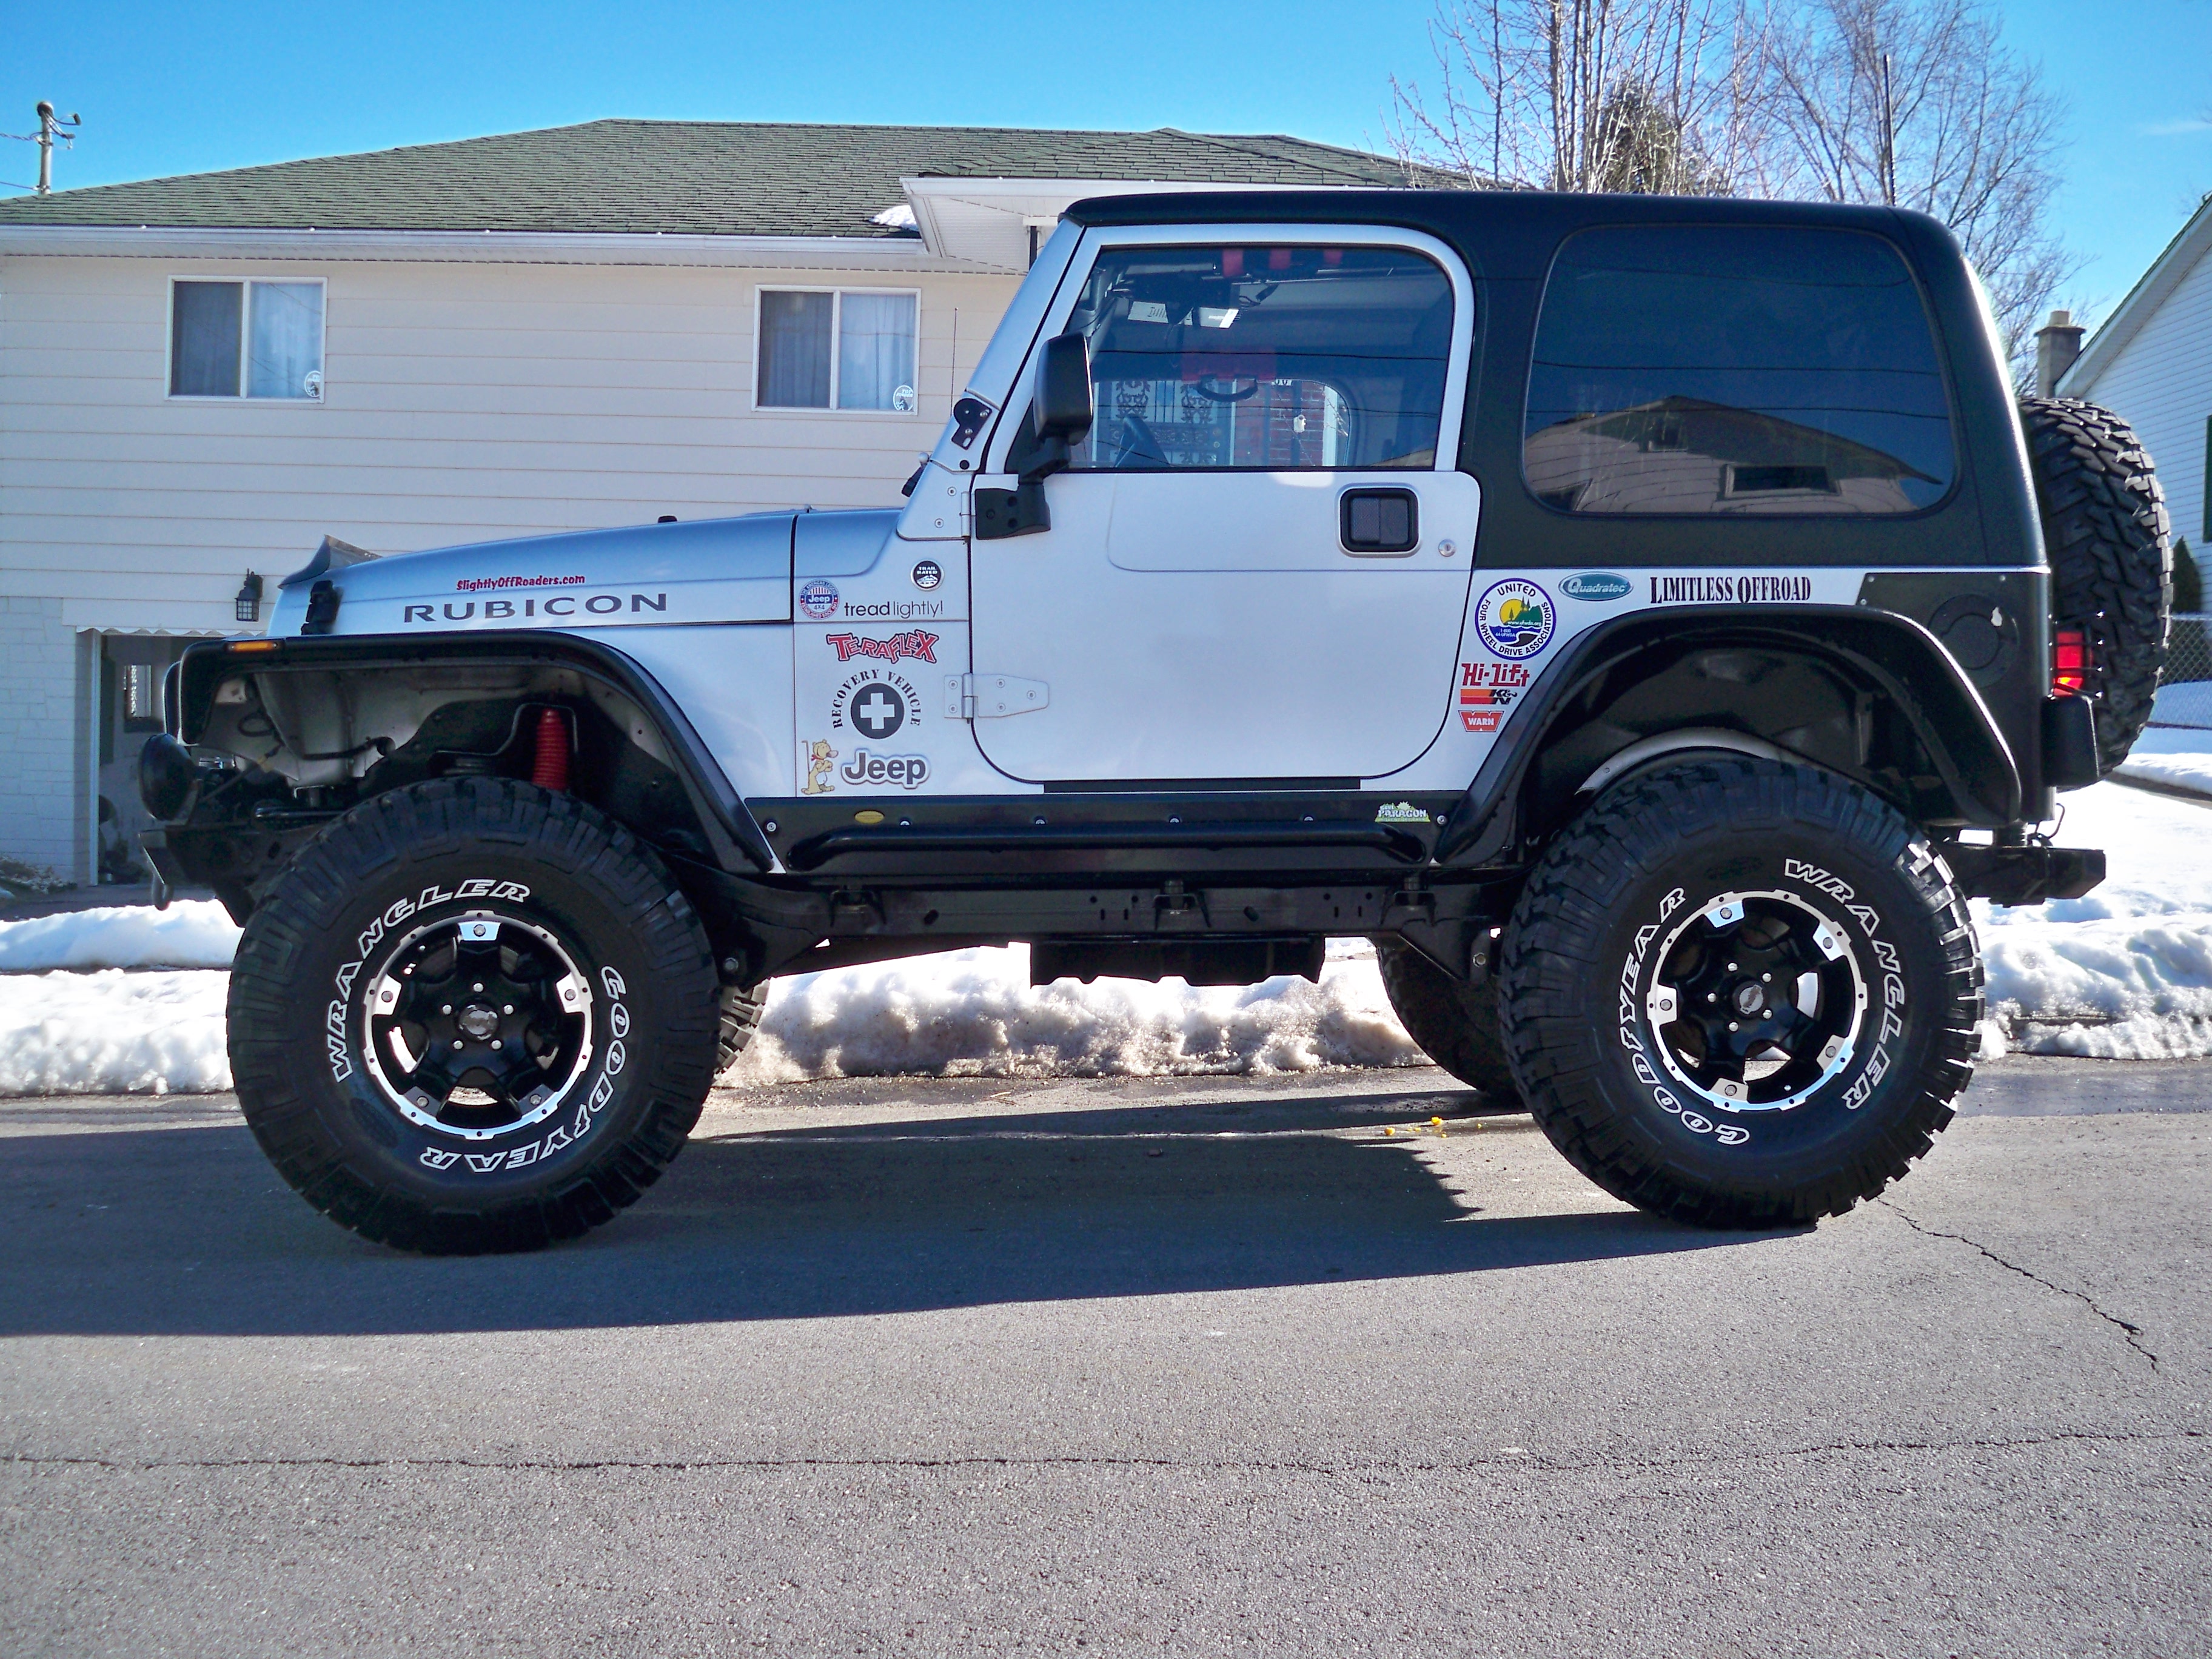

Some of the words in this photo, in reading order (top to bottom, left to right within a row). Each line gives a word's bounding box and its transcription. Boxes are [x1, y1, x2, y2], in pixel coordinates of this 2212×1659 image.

[456, 575, 585, 592] SlightlyOffRoaders.com
[1497, 583, 1536, 597] UNITED
[1568, 578, 1626, 594] Quadratec
[1650, 577, 1732, 603] LIMITLESS
[1737, 577, 1811, 603] OFFROAD
[404, 593, 667, 623] RUBICON
[808, 595, 830, 603] Jeep
[1480, 599, 1491, 621] FOUR
[1480, 623, 1497, 649] WHEEL
[1526, 602, 1552, 654] ASSOCIATIONS
[1498, 646, 1523, 655] DRIVE
[1461, 663, 1530, 687] Hi-Lift
[833, 669, 880, 729] RECOVERY
[887, 670, 922, 726] VEHICLE
[1467, 717, 1495, 726] WARN
[845, 752, 927, 785] Jeep
[1378, 809, 1427, 818] PARAGON
[327, 879, 531, 1083] WRANGLER
[1785, 858, 1905, 1110] WRANGLER
[1618, 887, 1751, 1145] GOODYEAR
[419, 965, 631, 1173] GOODYEAR
